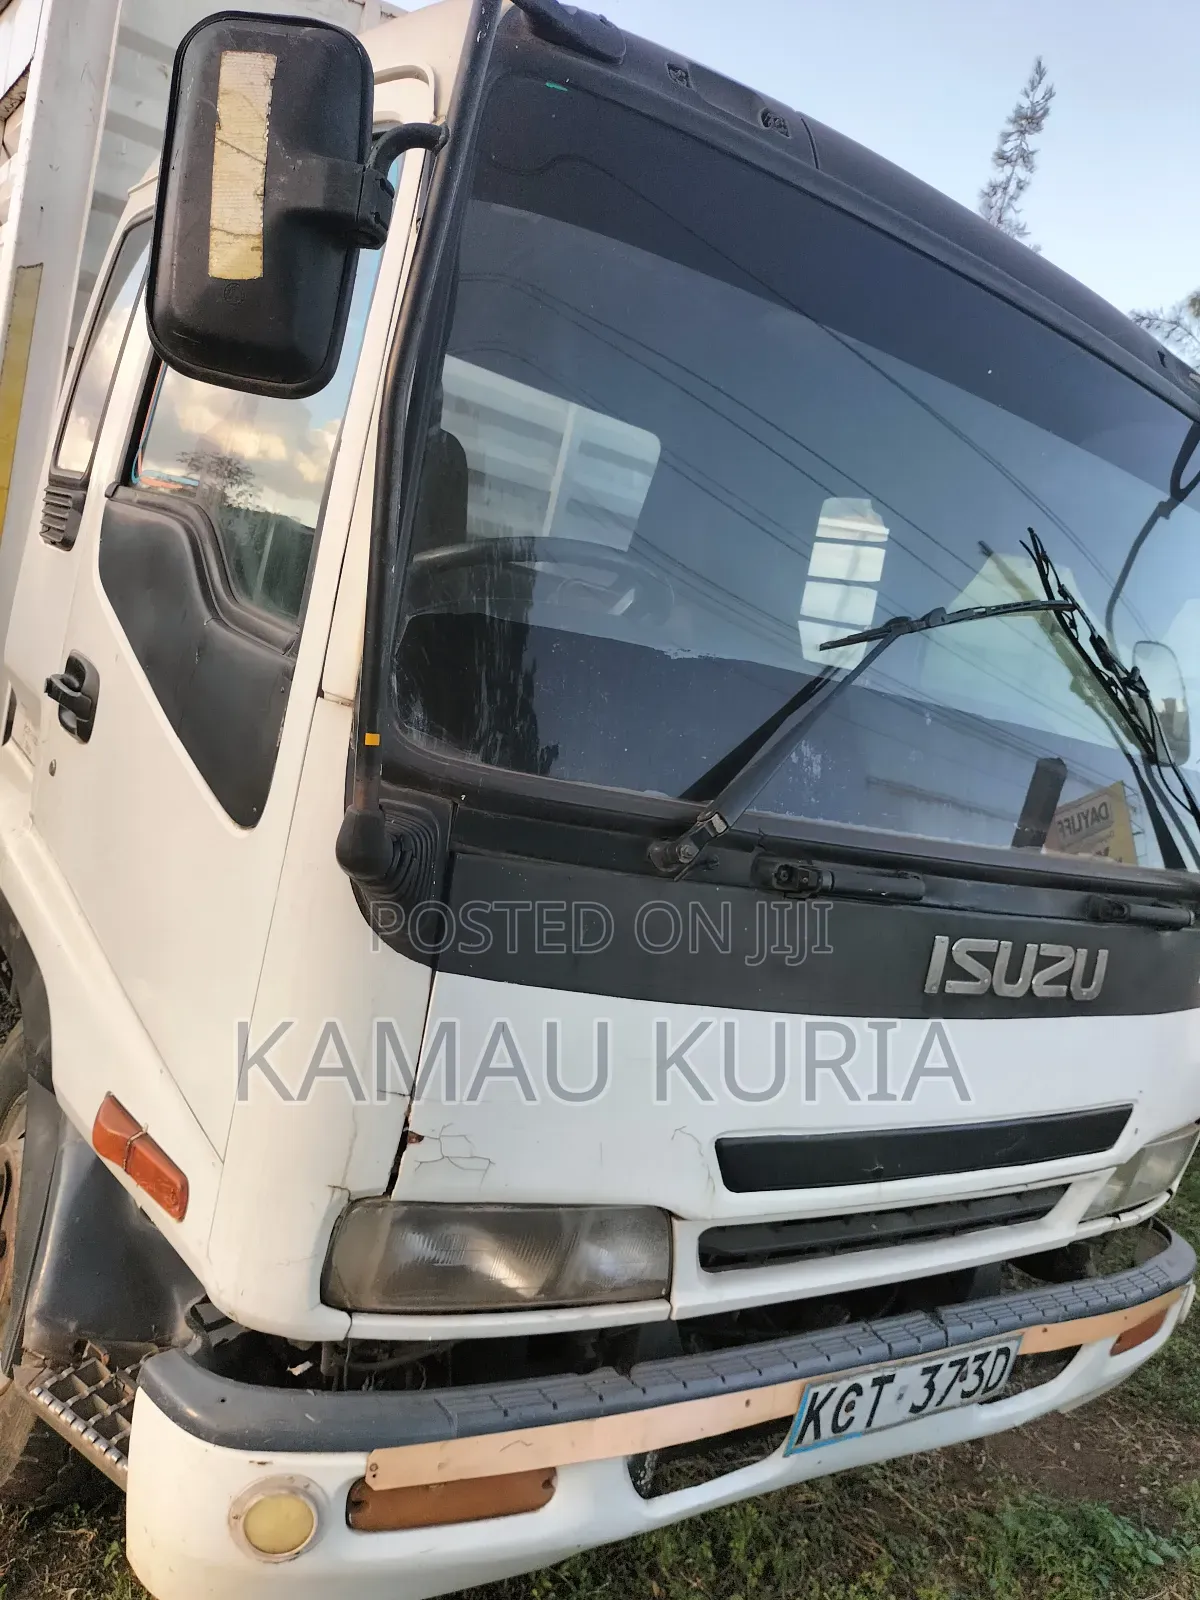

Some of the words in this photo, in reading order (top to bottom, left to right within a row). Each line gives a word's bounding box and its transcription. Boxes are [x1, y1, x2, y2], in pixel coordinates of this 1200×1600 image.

[924, 935, 1109, 1000] ISUZU
[797, 1373, 896, 1446] KCT
[909, 1346, 1011, 1414] 373D
